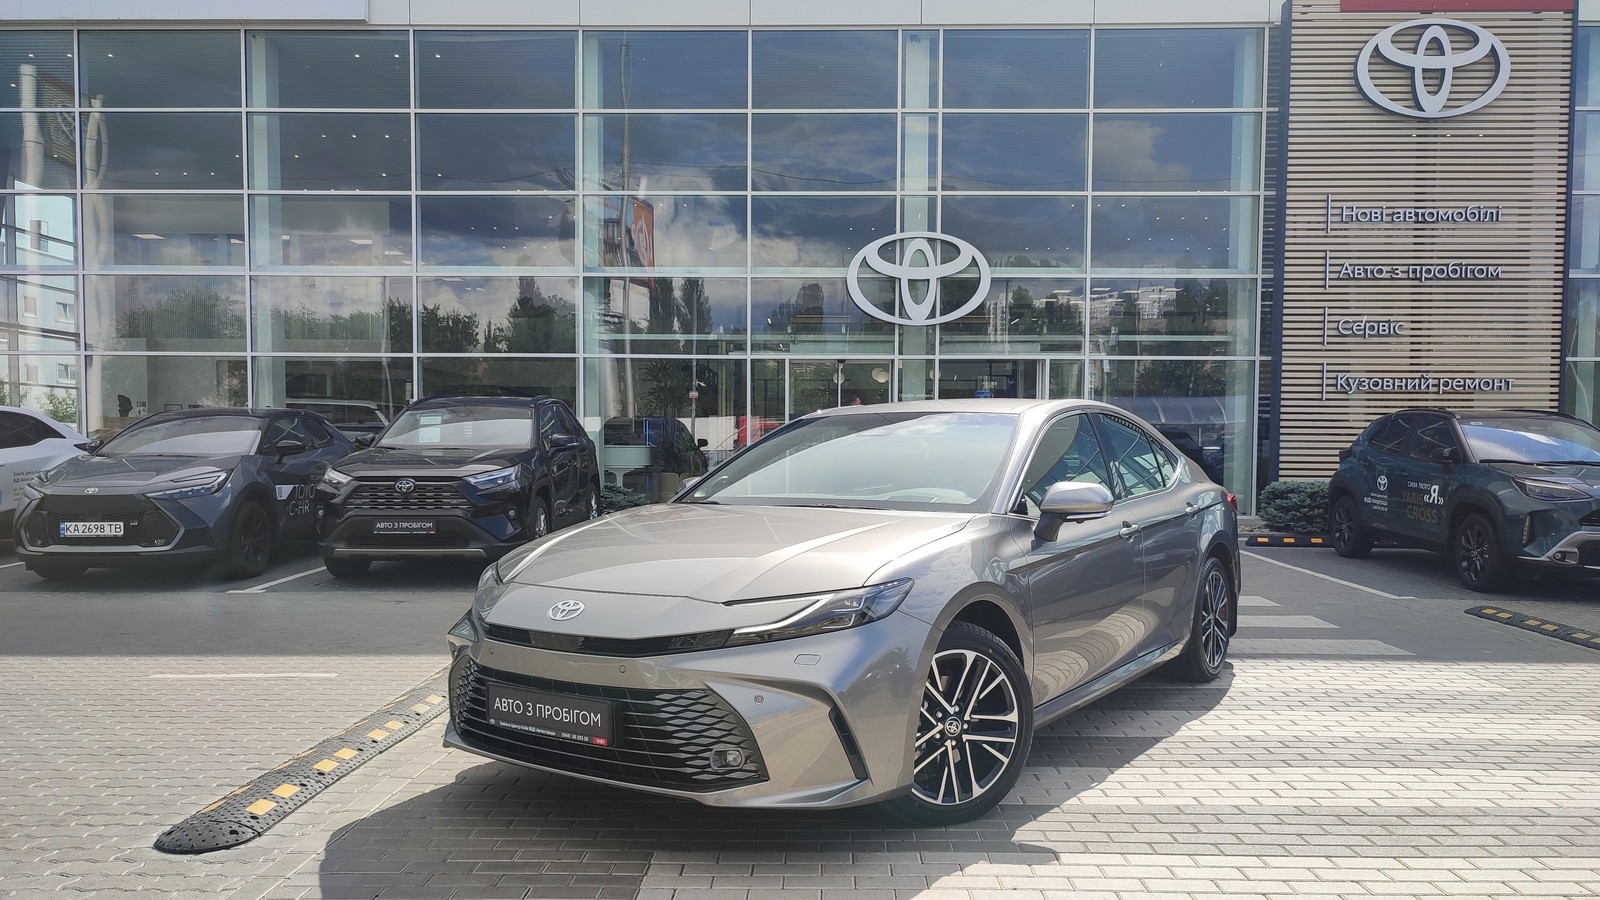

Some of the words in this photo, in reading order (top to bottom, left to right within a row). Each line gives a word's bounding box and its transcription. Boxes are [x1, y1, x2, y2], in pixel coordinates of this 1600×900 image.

[1341, 205, 1387, 222] Нові
[1392, 204, 1502, 223] автомобілі
[1338, 262, 1386, 278] Авто
[1391, 265, 1402, 278] з
[1408, 261, 1502, 282] пробігом
[1337, 318, 1406, 338] Сервіс
[1336, 374, 1433, 394] Кузовний
[1438, 377, 1515, 394] ремонт
[293, 483, 318, 499] TOYO
[1401, 490, 1424, 506] YARIS
[288, 500, 310, 516] C-HR
[1406, 505, 1438, 523] CROSS
[81, 523, 106, 534] 2698
[493, 697, 524, 715] АВТО
[536, 704, 601, 728] ПРОБІГОМ
